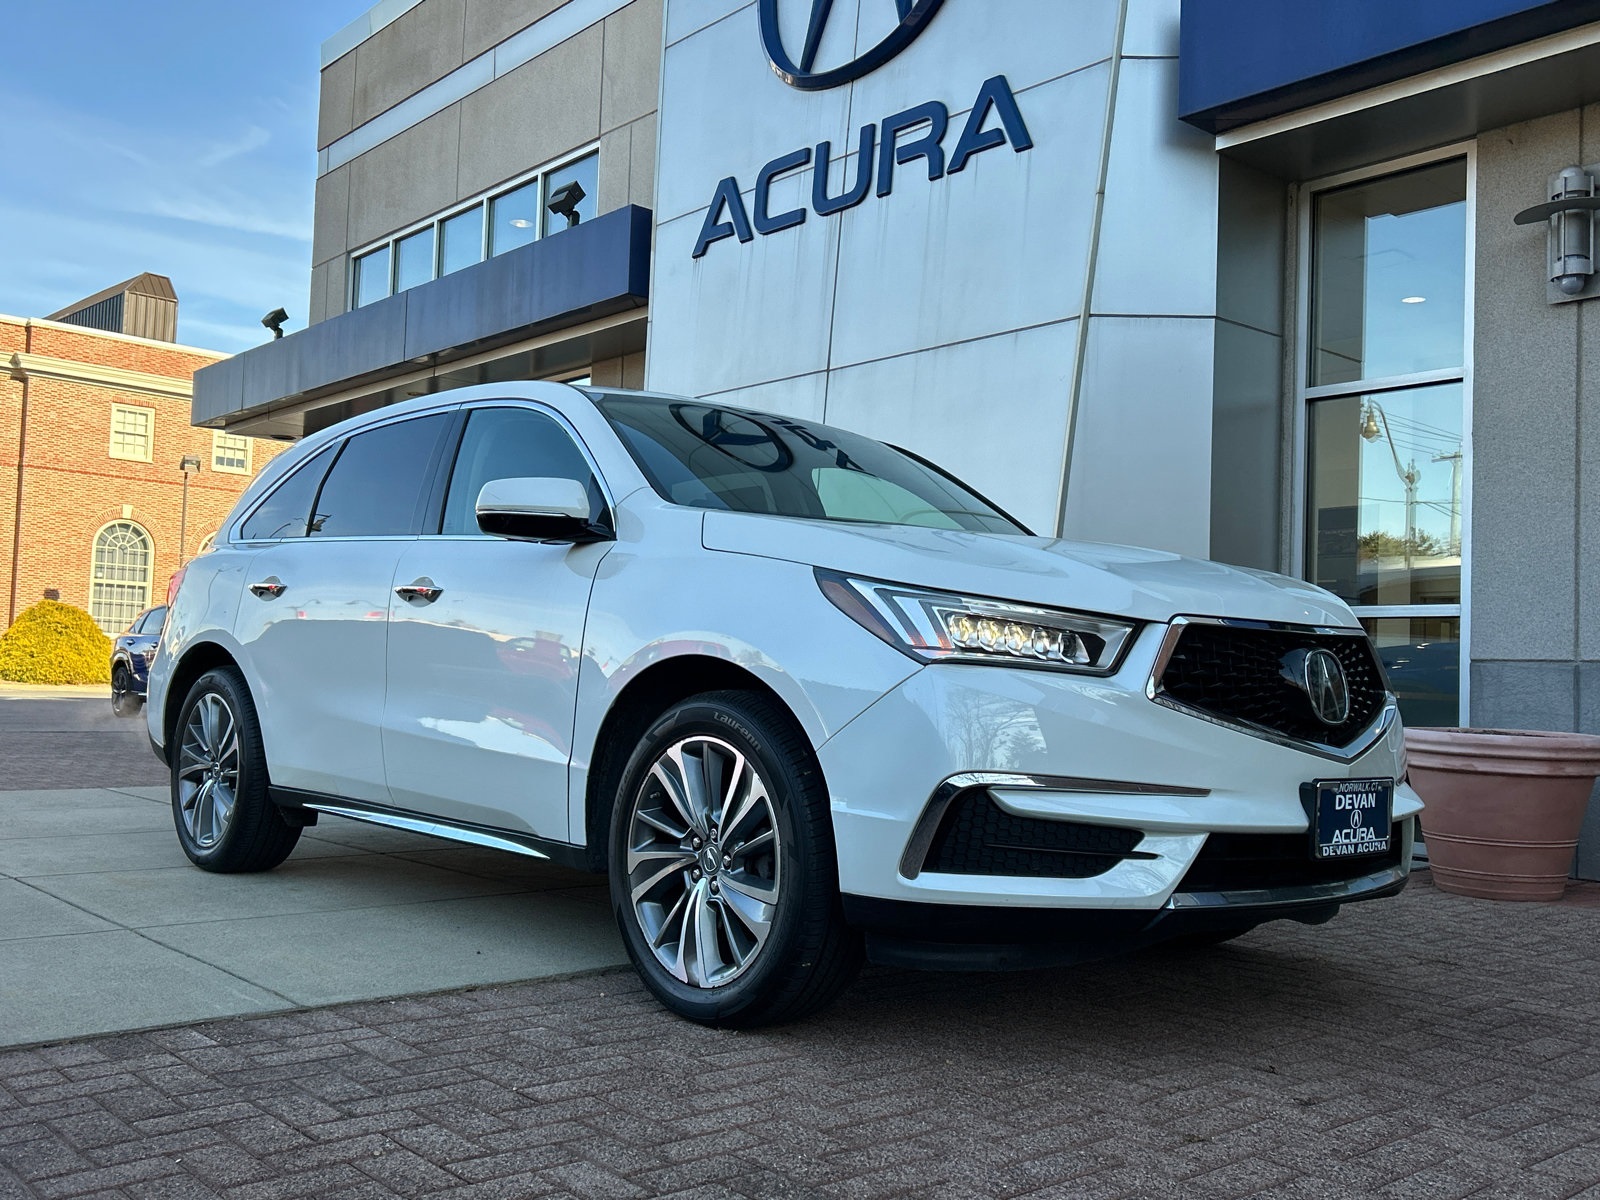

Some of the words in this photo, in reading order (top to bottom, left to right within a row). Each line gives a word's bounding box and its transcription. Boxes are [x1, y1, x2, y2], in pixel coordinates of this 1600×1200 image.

[691, 74, 1034, 258] ACURA
[1371, 782, 1379, 791] CT
[1335, 793, 1376, 810] DEVAN
[1332, 826, 1376, 844] ACURA
[1323, 844, 1355, 857] DEVAN
[1357, 841, 1386, 853] ACURA
